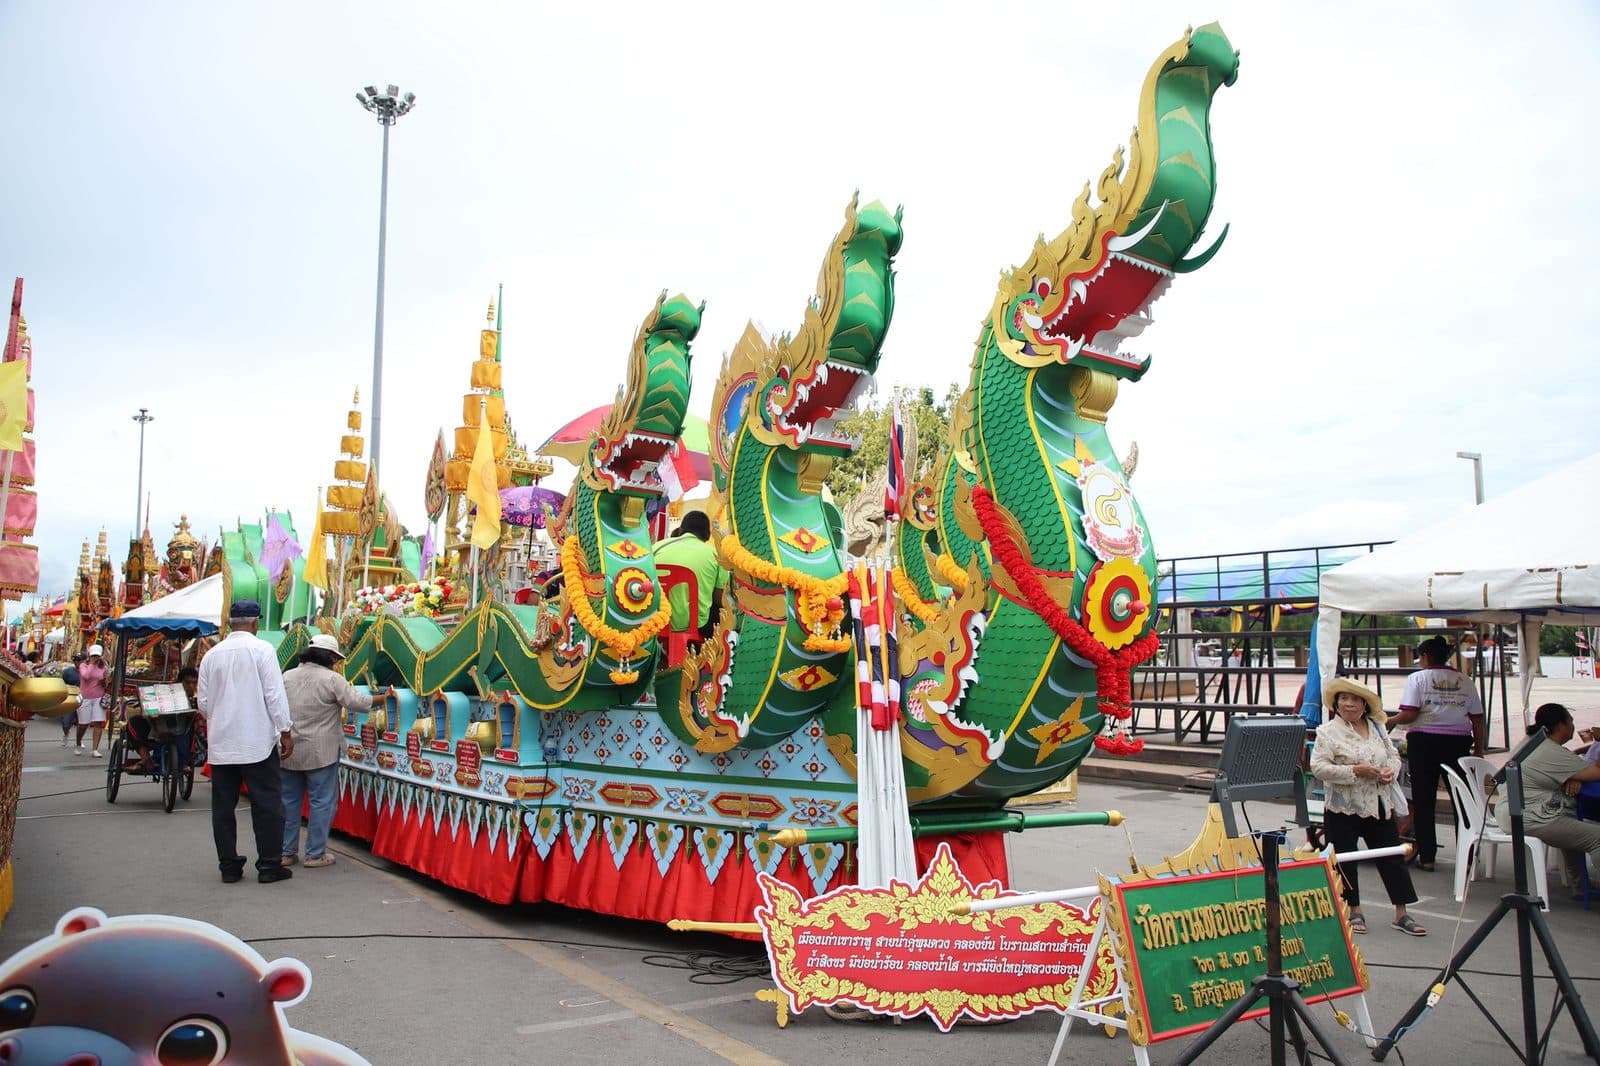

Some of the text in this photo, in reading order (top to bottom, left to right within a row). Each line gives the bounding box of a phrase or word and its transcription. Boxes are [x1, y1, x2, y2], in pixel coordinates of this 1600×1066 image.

[954, 936, 995, 951] คลองยัน
[1000, 936, 1090, 955] โบราณสถานสำคัญ
[807, 949, 846, 968] ถ้ำสิงขร
[849, 951, 903, 969] มีบ่อน้ำร้อน
[907, 953, 959, 972] คลองน้ำใส
